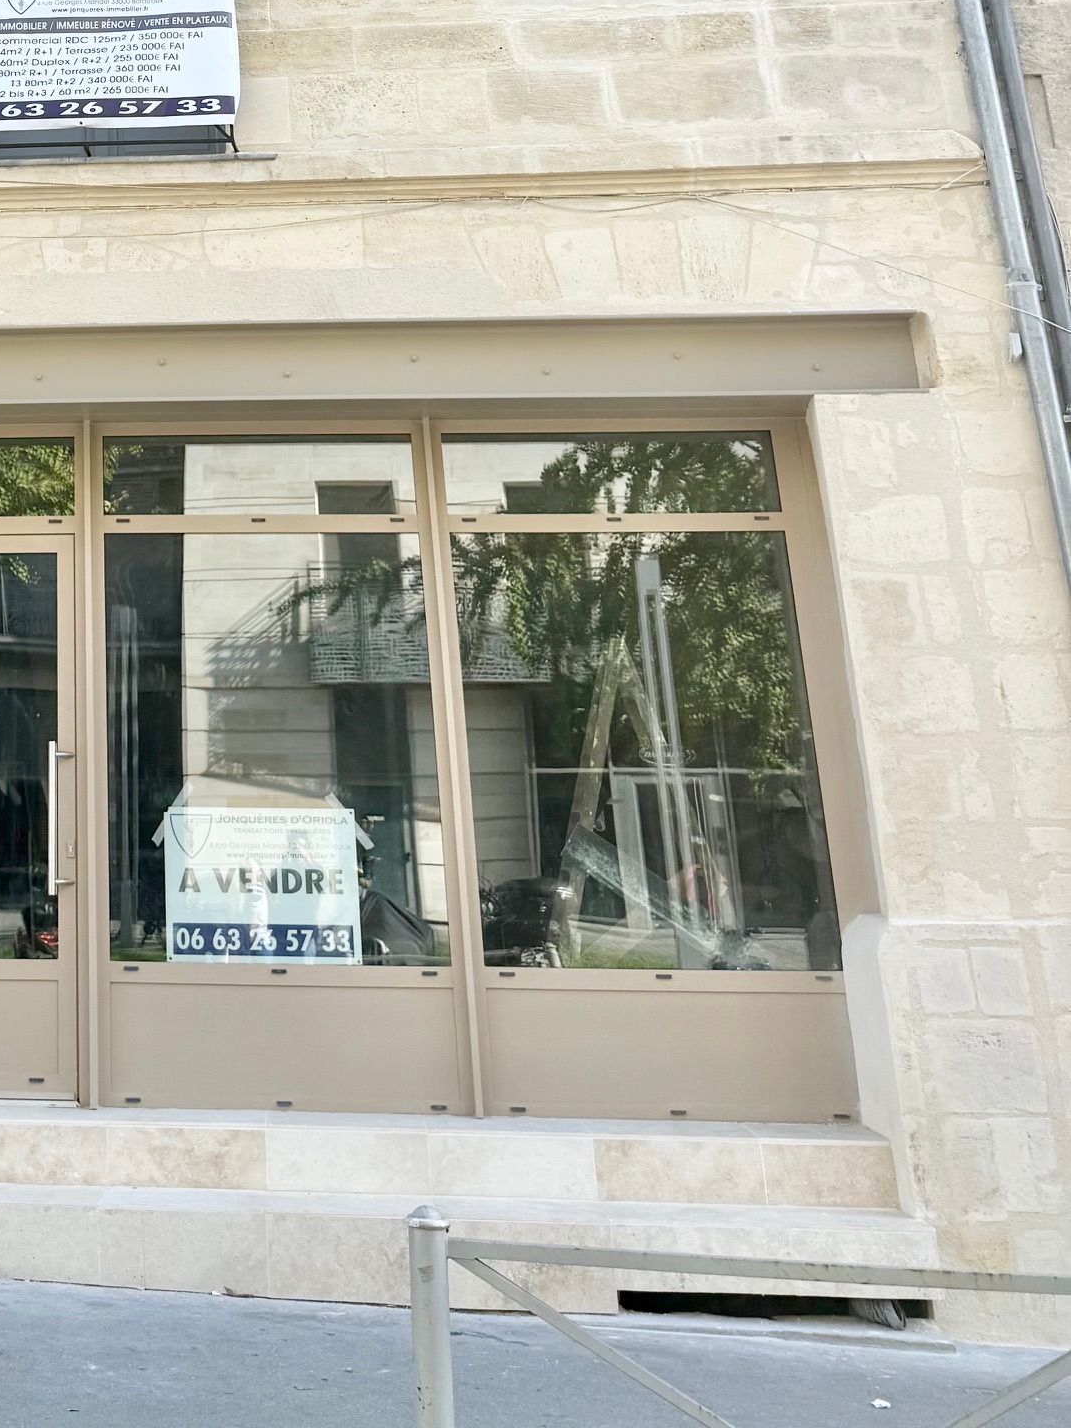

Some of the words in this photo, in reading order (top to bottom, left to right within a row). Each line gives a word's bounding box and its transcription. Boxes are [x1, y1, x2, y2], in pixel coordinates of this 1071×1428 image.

[56, 20, 99, 30] IMMEUBLE
[101, 18, 136, 29] RÉNOVÉ
[143, 17, 170, 27] VENTE
[172, 16, 184, 25] EN
[185, 15, 228, 25] PLATEAUX
[65, 36, 89, 44] RDC
[138, 32, 157, 41] 350
[187, 31, 203, 39] FAI
[34, 47, 53, 55] R+1
[119, 43, 139, 52] 235
[169, 42, 185, 50] FAI
[31, 58, 70, 67] Duplex
[81, 56, 102, 64] R+2
[113, 54, 133, 63] 255
[163, 53, 179, 61] FAI
[29, 69, 48, 77] R+1
[115, 64, 134, 73] 360
[165, 63, 181, 72] FAI
[10, 79, 21, 87] T3
[56, 78, 76, 86] R+2
[87, 76, 107, 84] 340
[137, 74, 153, 83] FAI
[9, 90, 25, 98] bis
[27, 89, 47, 97] R+3
[58, 88, 72, 96] 60
[102, 86, 122, 94] 265
[153, 86, 169, 94] FAI
[1, 102, 45, 117] 63
[59, 101, 103, 116] 26
[118, 100, 163, 114] 57
[176, 98, 222, 112] 33
[178, 867, 201, 893] A
[212, 867, 344, 895] VENDRE
[176, 927, 205, 950] 06
[212, 928, 241, 951] 63
[249, 929, 277, 951] 26
[285, 929, 314, 952] 57
[322, 930, 351, 952] 33
